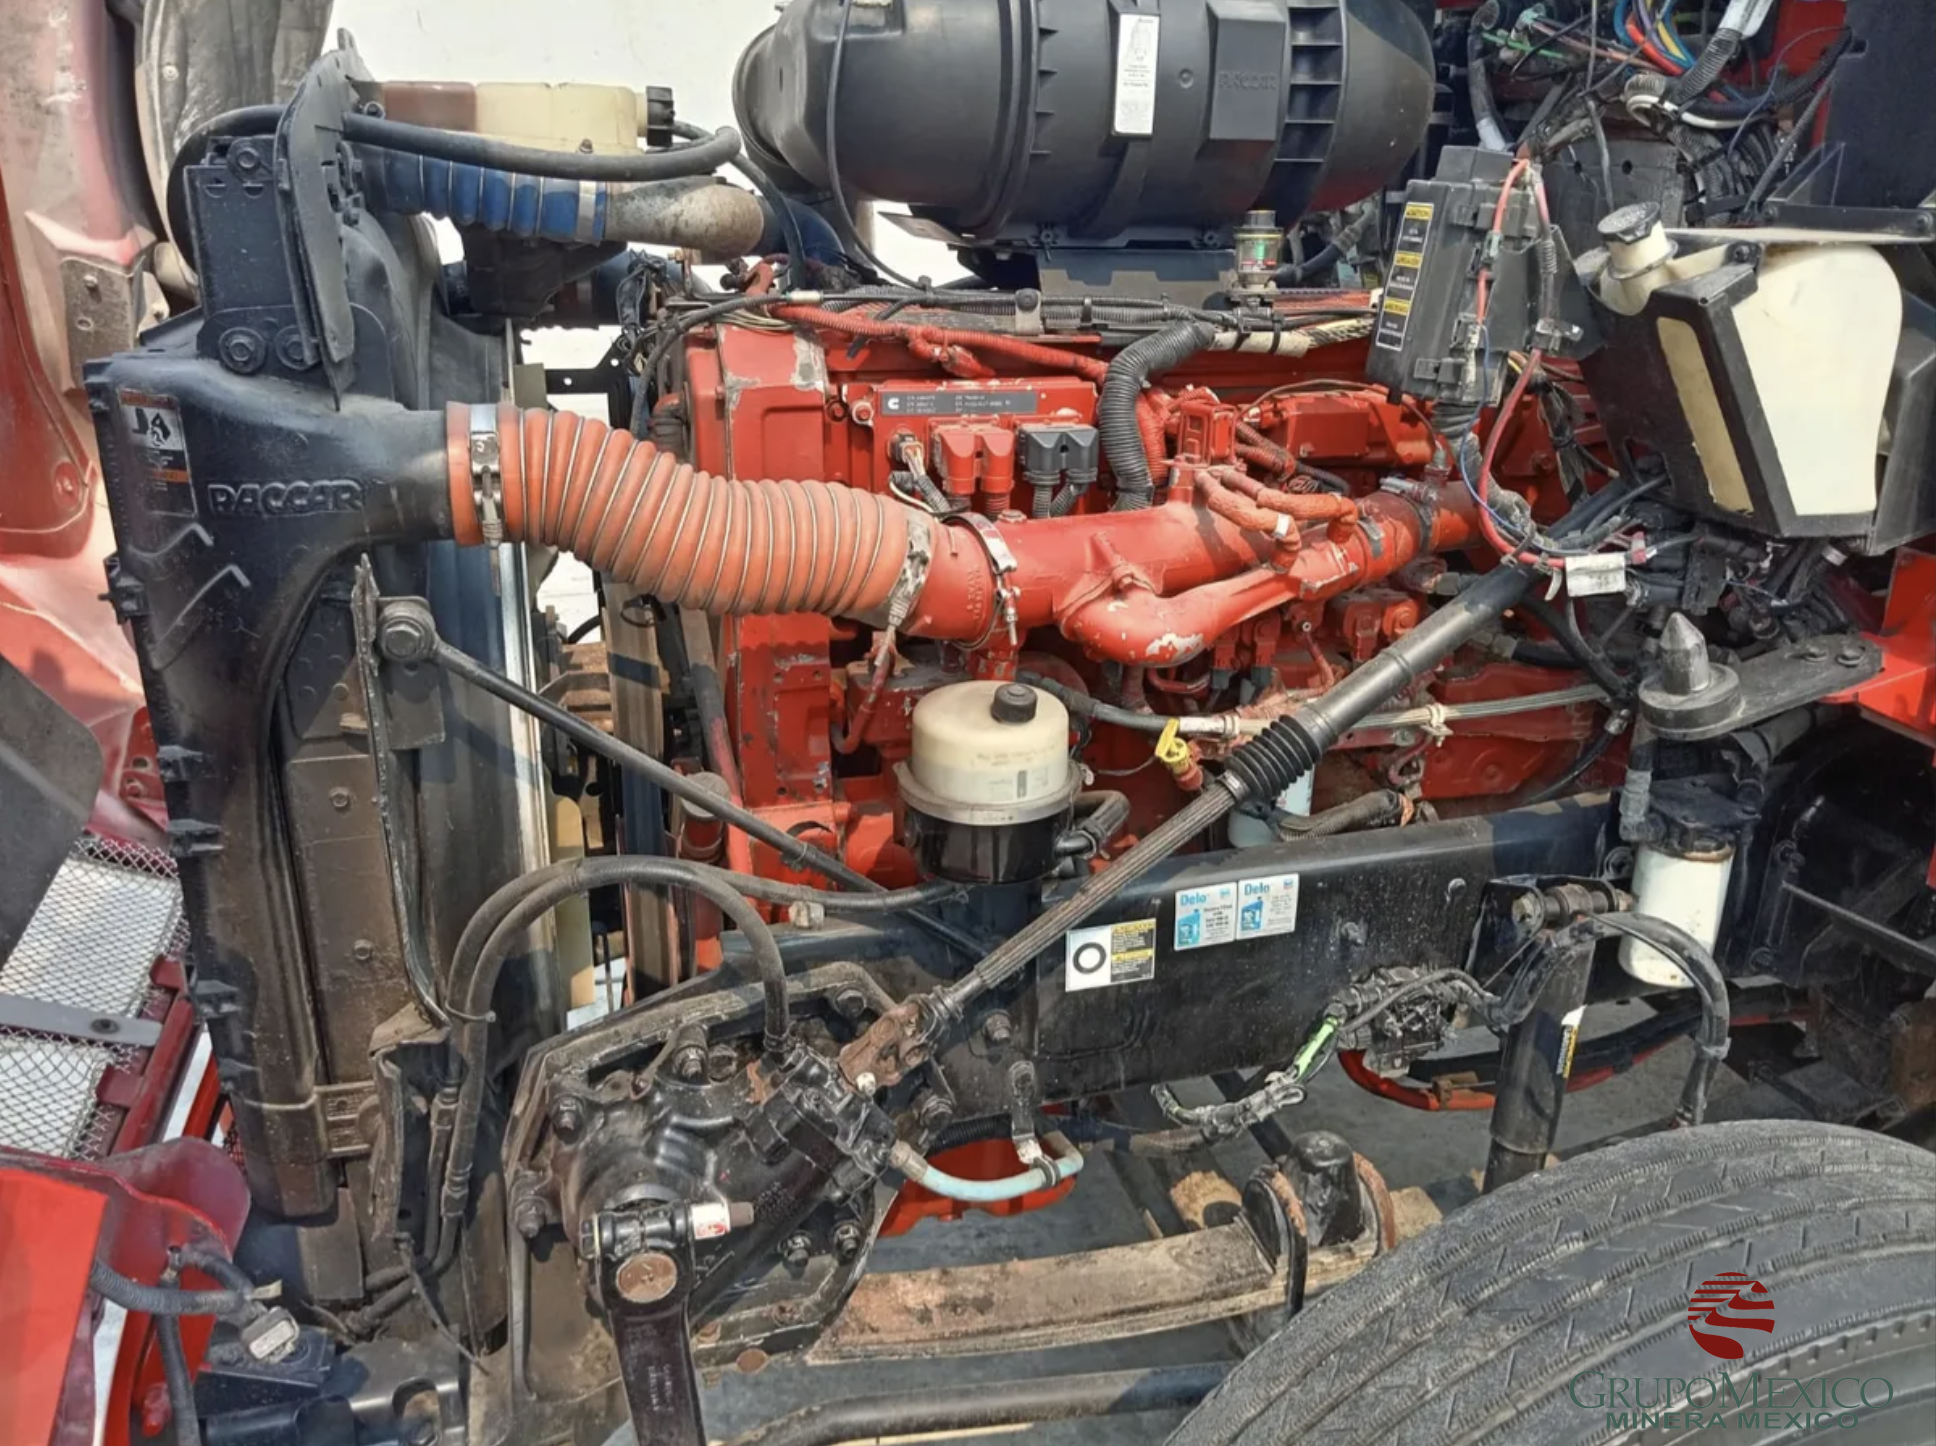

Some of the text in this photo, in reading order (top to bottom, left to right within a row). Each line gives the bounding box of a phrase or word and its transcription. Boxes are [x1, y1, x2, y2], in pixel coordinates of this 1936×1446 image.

[206, 479, 363, 516] PACCAR
[1244, 882, 1270, 896] Delo
[1181, 892, 1206, 906] Delo
